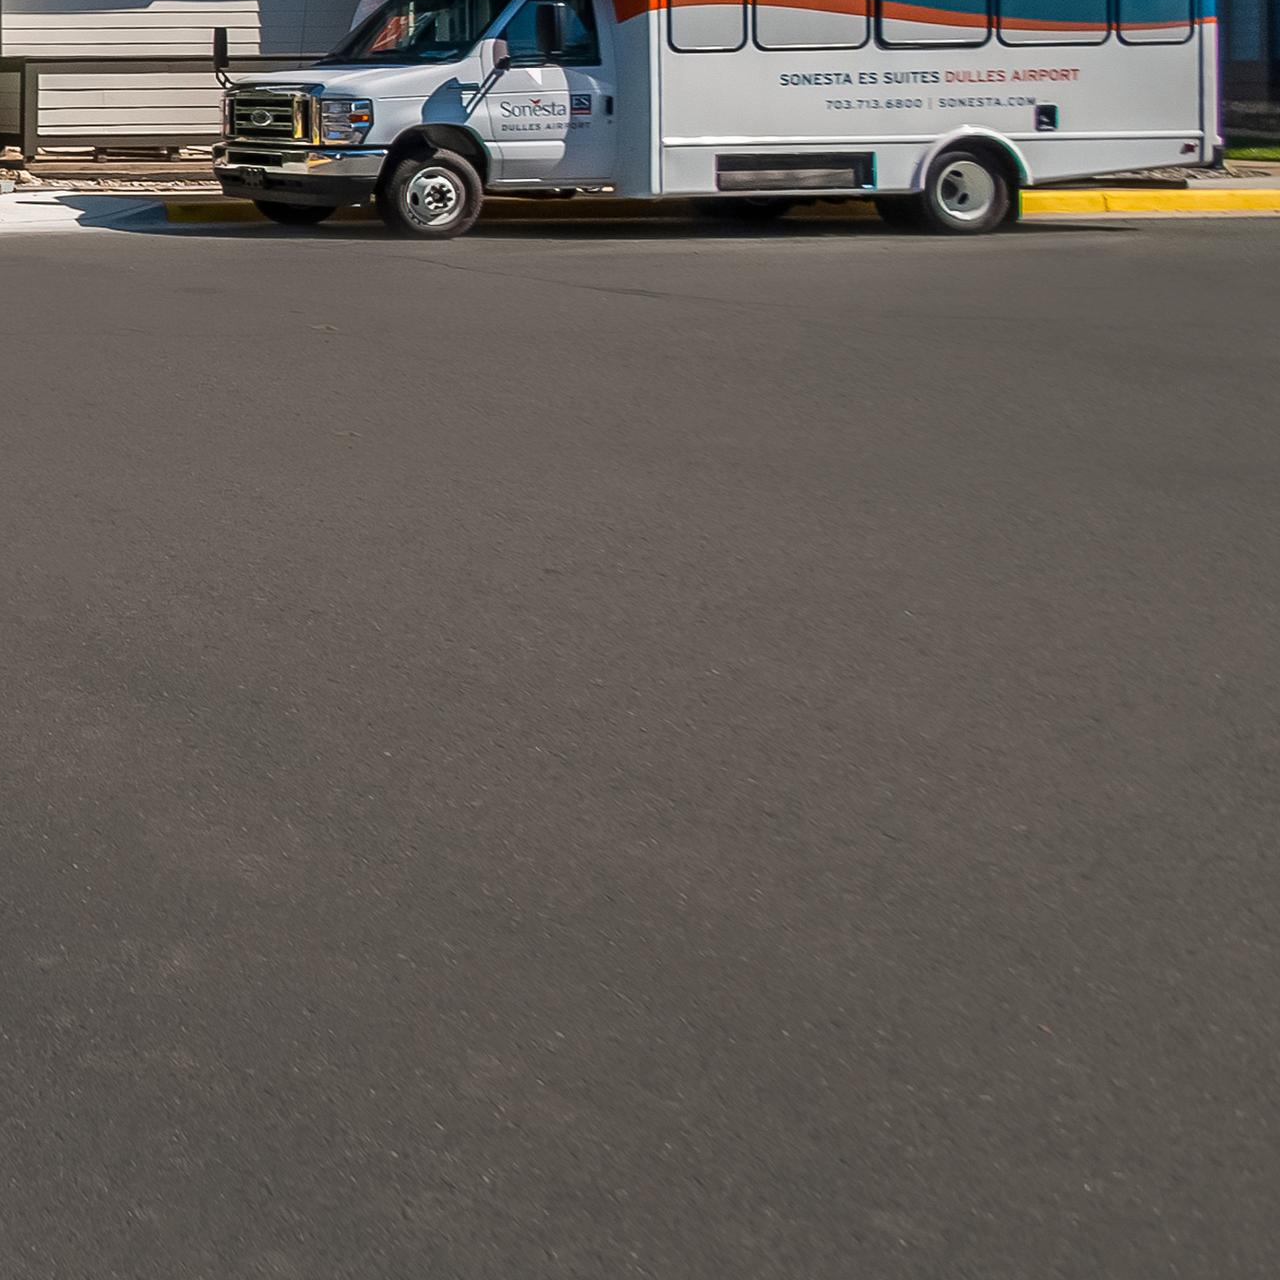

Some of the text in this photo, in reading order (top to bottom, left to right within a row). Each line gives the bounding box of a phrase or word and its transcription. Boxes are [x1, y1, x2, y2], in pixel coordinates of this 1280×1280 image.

[779, 68, 1080, 86] SONESTA ES SUITES DULLES AIRPORT
[939, 96, 1037, 108] SONESTA.COM
[500, 101, 567, 118] Sonesta
[501, 122, 592, 132] DULLES AIRPORT
